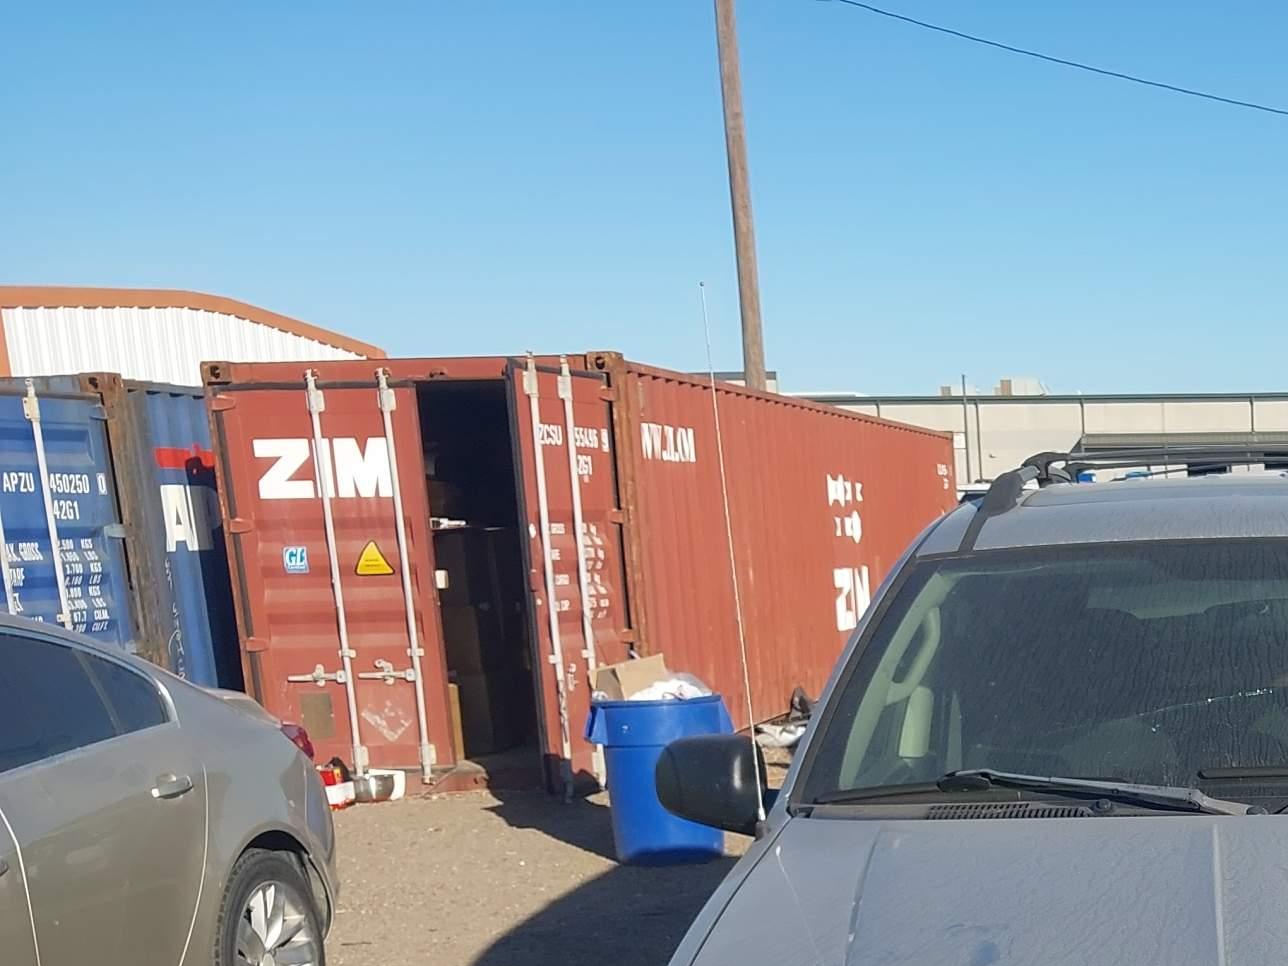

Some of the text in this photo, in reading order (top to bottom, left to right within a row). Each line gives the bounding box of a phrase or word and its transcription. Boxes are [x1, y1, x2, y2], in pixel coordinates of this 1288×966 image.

[537, 424, 563, 446] ZCSU
[252, 437, 395, 499] ZIM
[3, 471, 35, 493] APZU
[49, 472, 90, 494] 450250
[54, 499, 80, 520] 42G1
